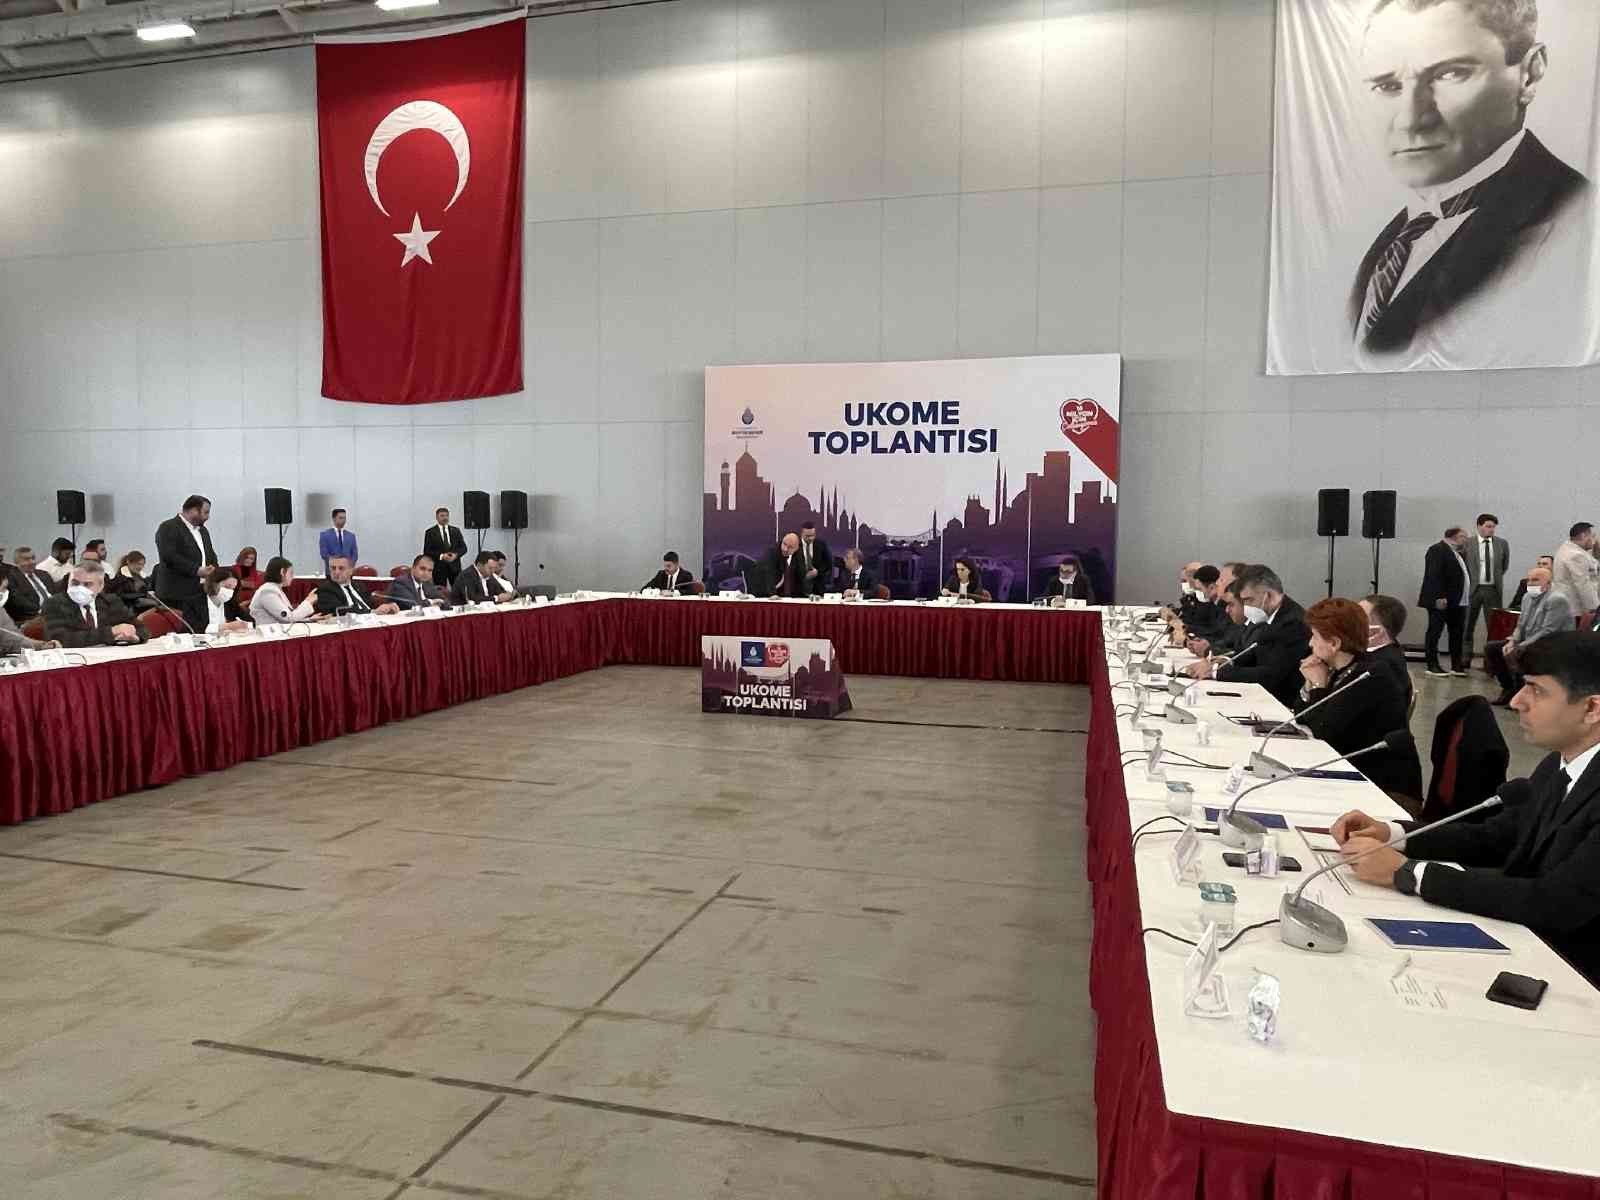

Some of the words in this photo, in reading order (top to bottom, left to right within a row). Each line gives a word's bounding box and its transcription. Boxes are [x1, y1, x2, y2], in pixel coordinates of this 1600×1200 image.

[844, 400, 960, 426] UKOME
[808, 429, 998, 454] TOPLANTISI
[740, 684, 791, 697] UKOME
[723, 695, 807, 711] TOPLANTISI
